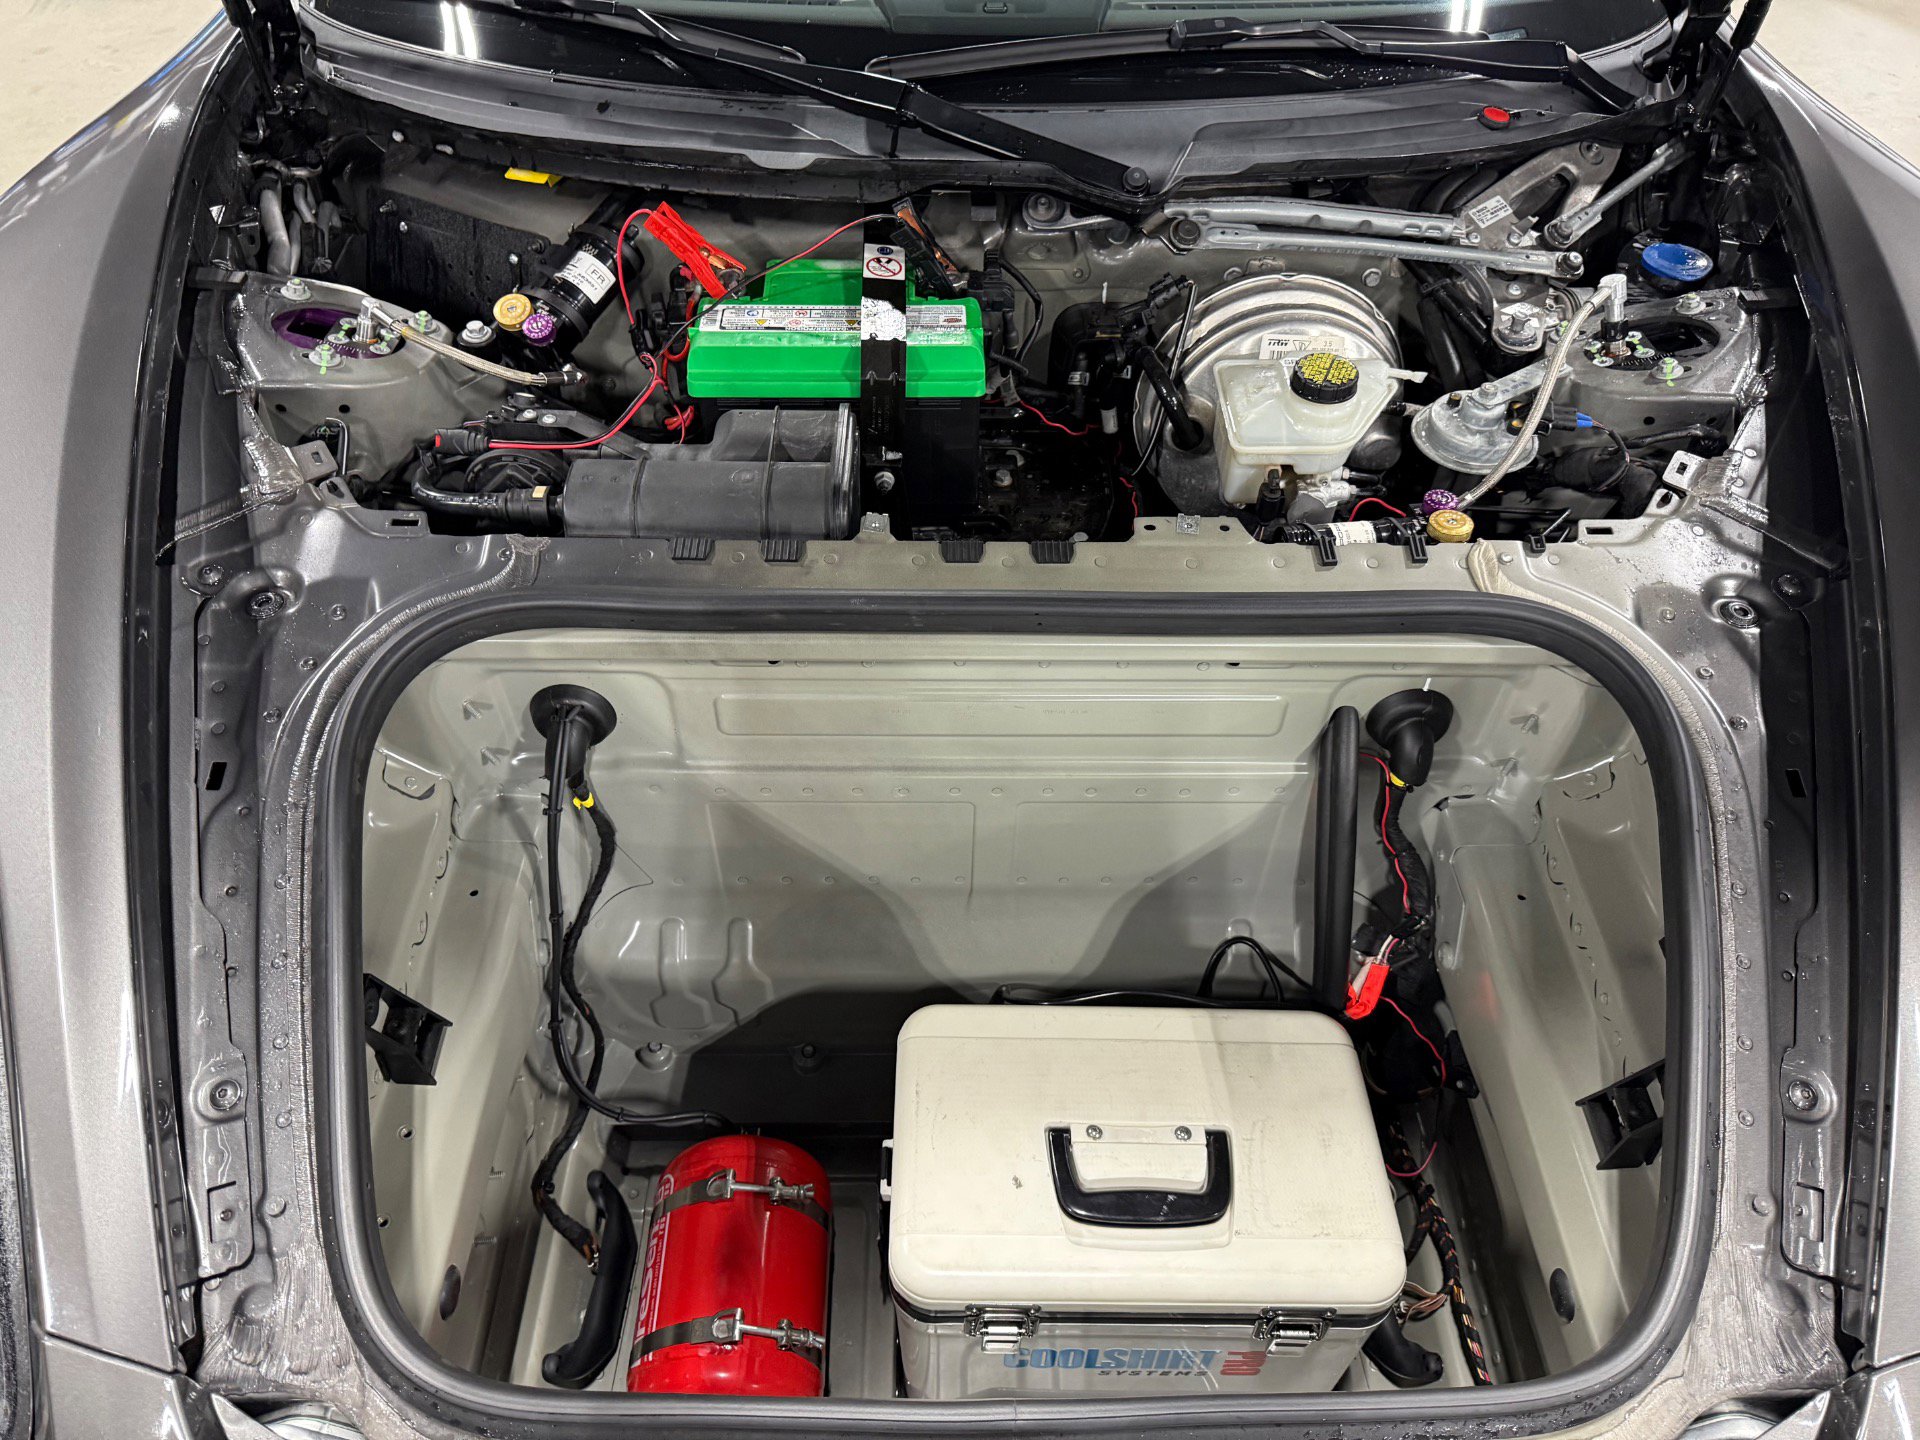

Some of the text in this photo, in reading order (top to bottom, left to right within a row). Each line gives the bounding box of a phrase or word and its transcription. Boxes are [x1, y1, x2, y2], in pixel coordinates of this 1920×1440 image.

[590, 269, 606, 285] FR
[1267, 338, 1290, 347] TRW
[1003, 1347, 1222, 1369] COOLSHIRT
